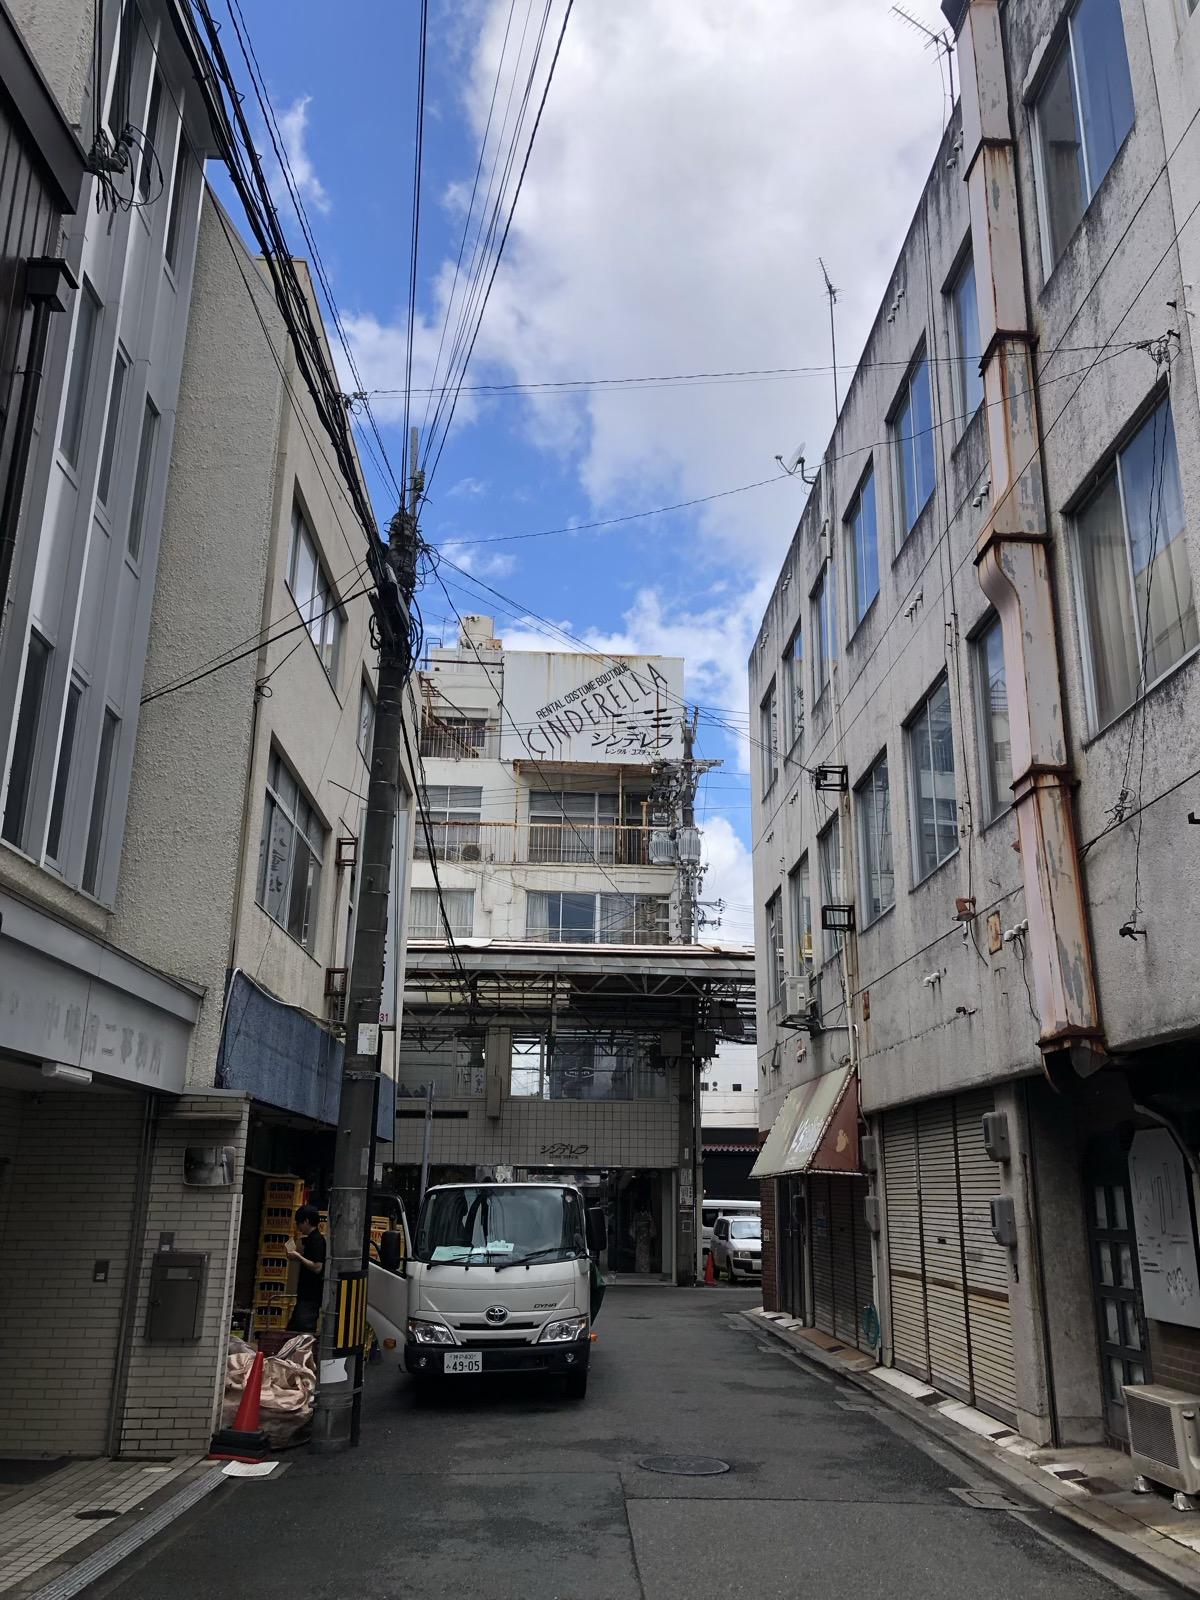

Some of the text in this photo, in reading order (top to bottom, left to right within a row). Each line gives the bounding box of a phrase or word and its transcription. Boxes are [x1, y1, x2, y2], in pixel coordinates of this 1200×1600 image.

[527, 663, 668, 754] CINDERELLA
[536, 662, 630, 720] RENTAL COSTUME BOUTIQUE
[591, 732, 673, 749] シンデレラ
[452, 1360, 480, 1371] 49-05
